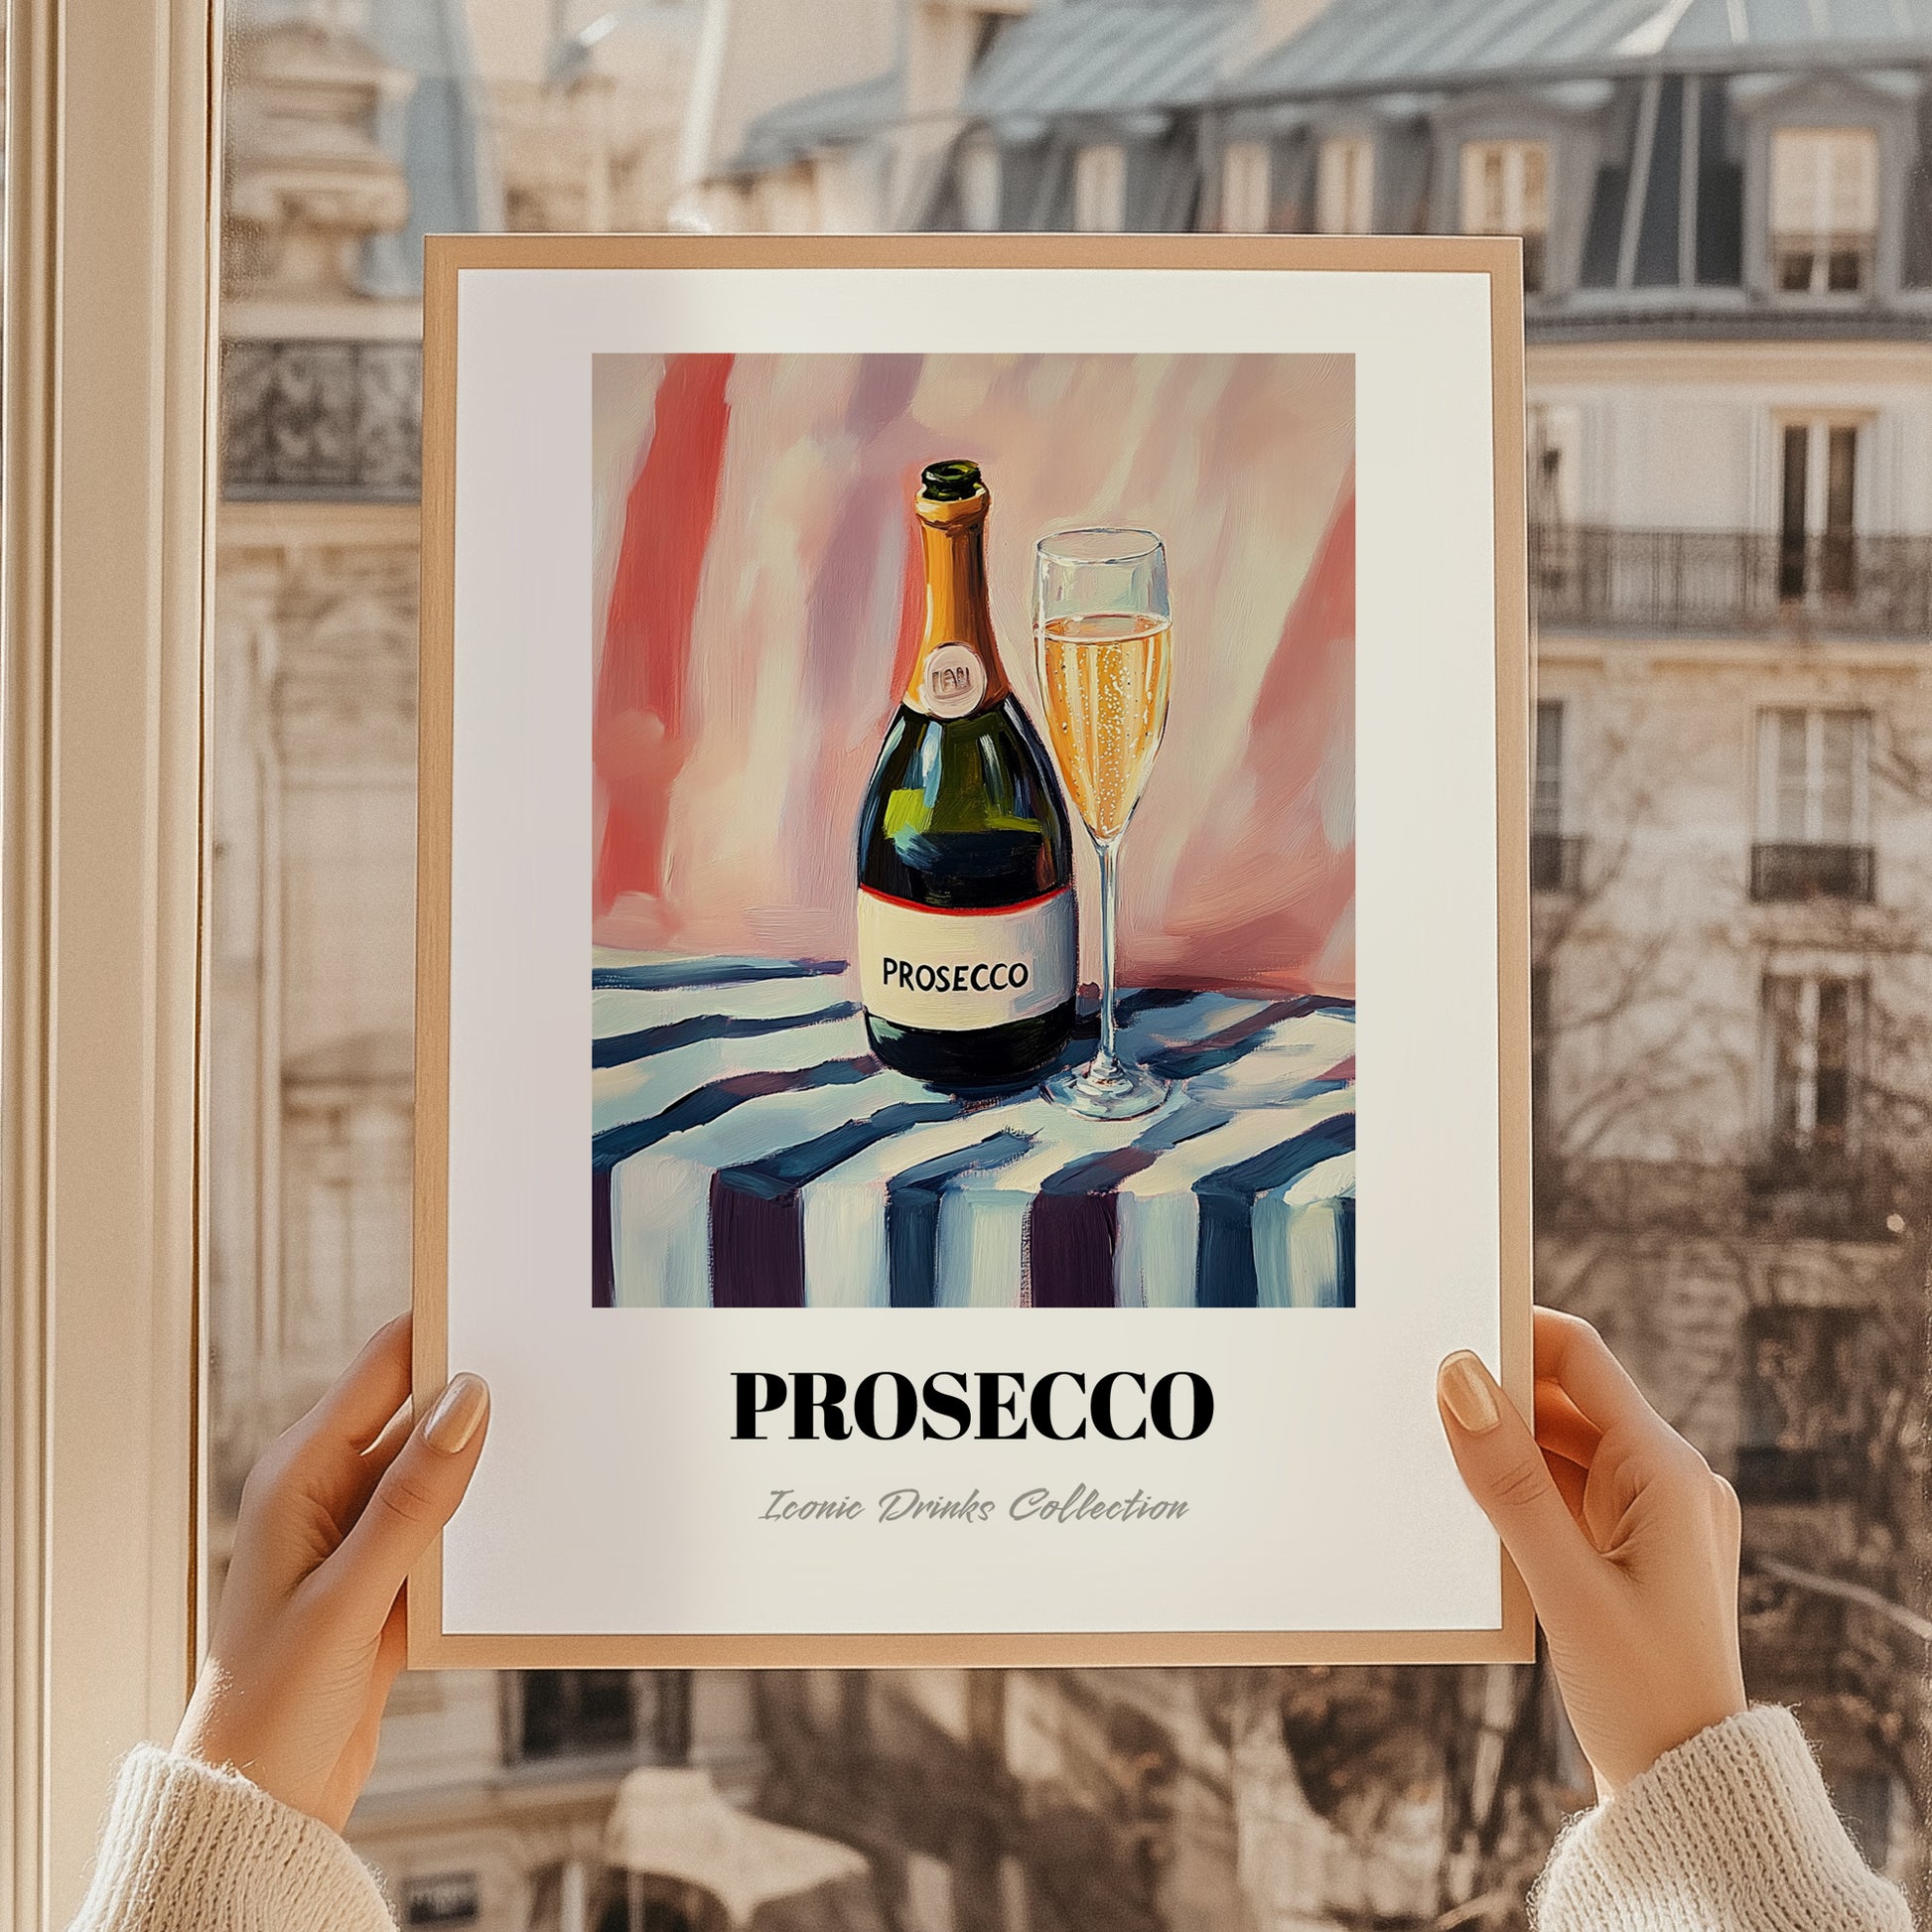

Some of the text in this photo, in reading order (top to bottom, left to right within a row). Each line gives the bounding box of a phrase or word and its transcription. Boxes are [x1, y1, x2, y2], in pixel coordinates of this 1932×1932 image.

[882, 957, 1030, 993] PROSECCO
[730, 1371, 1214, 1441] PROSECCO
[759, 1481, 1190, 1524] Iconic Drinks Collection
